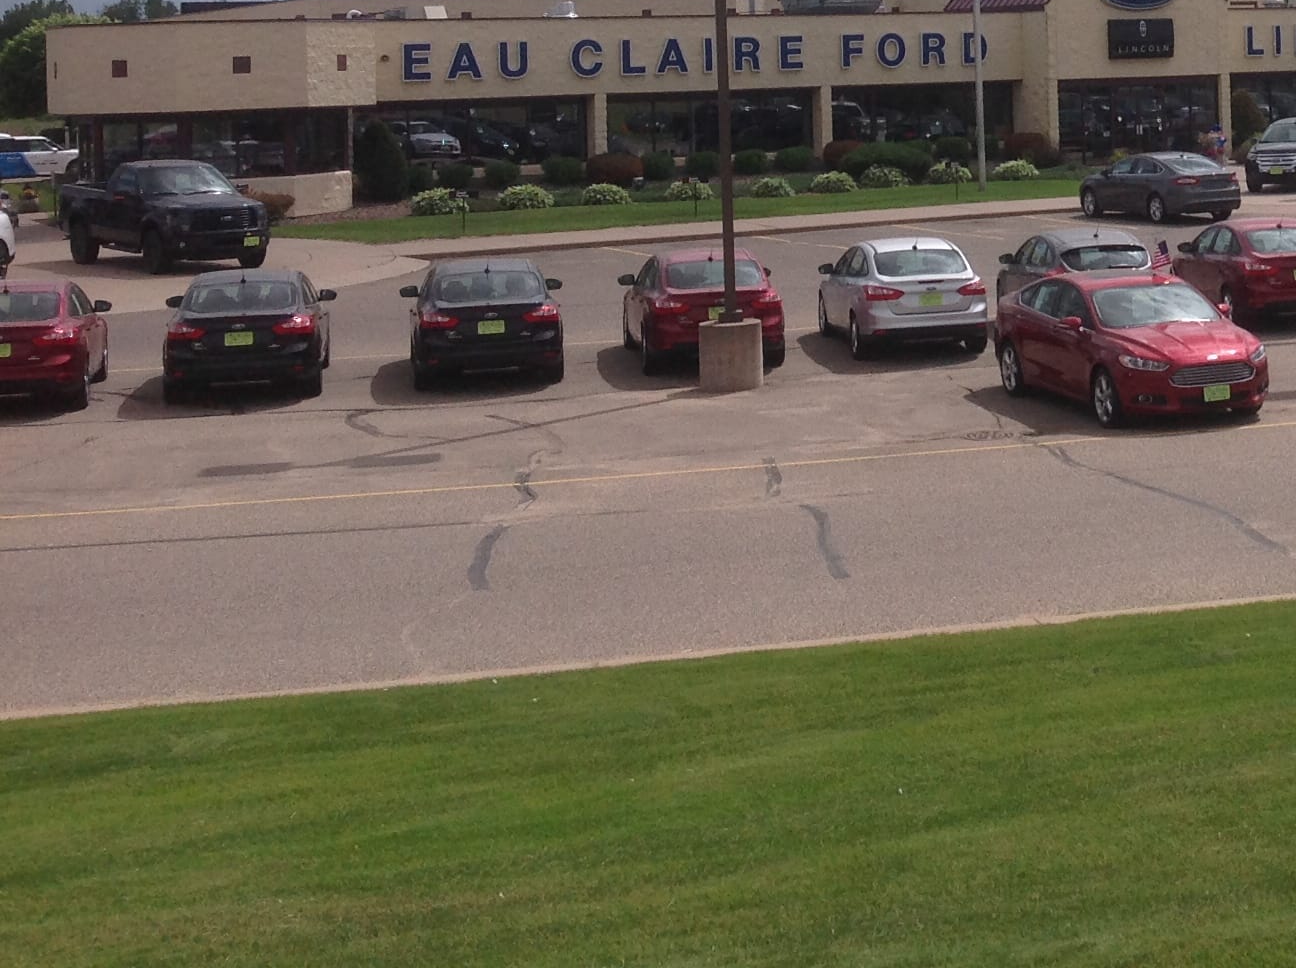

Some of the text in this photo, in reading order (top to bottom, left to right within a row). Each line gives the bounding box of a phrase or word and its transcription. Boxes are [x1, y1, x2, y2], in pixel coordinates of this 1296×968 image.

[402, 31, 988, 82] EAU CLAIRE FORD
[1117, 44, 1170, 55] LINCOLN
